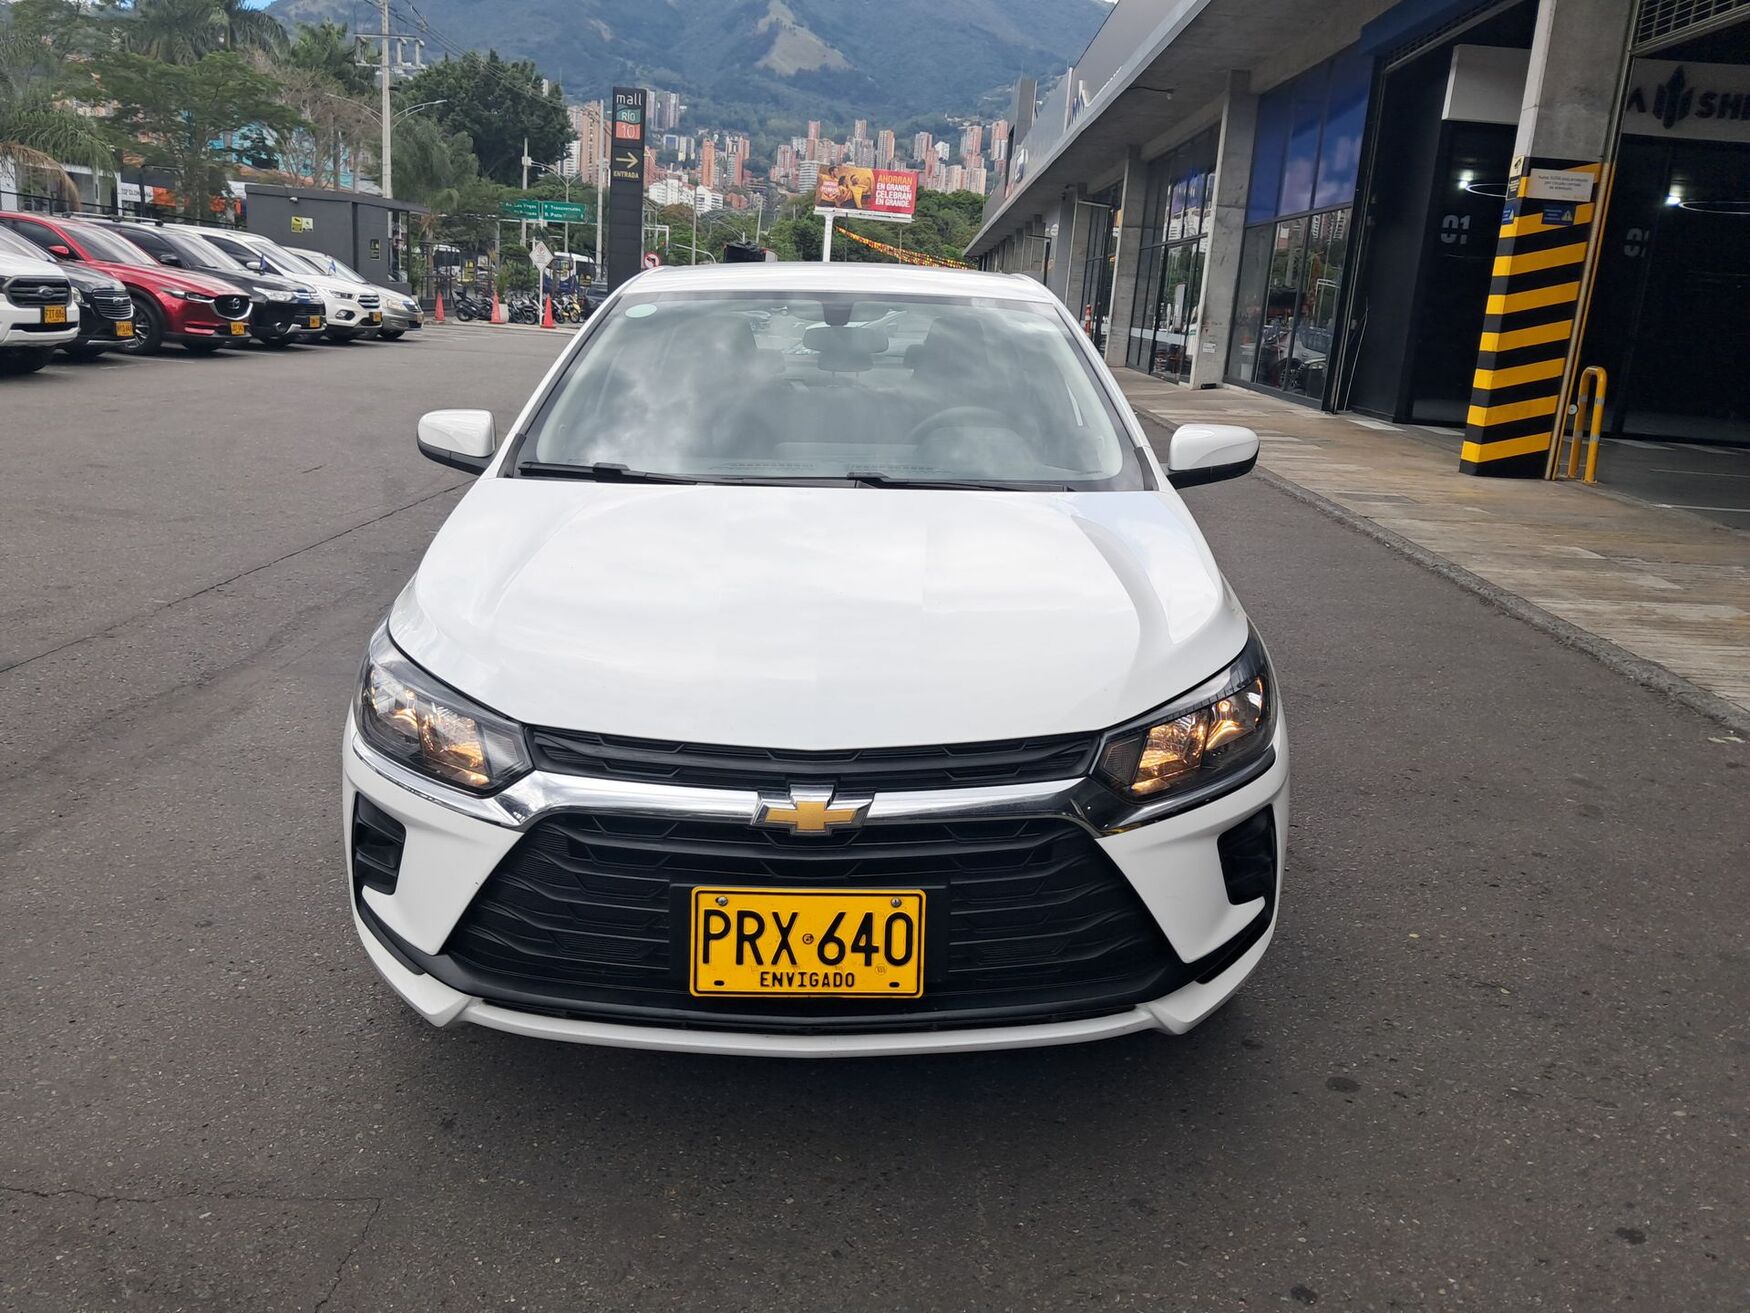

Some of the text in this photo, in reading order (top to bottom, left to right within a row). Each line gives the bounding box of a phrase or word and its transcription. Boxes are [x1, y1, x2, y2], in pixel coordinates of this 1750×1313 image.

[616, 93, 642, 105] mall
[621, 125, 635, 138] 10
[879, 174, 912, 184] AHORRAN
[875, 190, 912, 201] CELEBRAN
[875, 198, 884, 206] EN
[1441, 214, 1471, 245] 01
[702, 908, 914, 967] PRX 640
[759, 971, 855, 989] ENVIGADO
